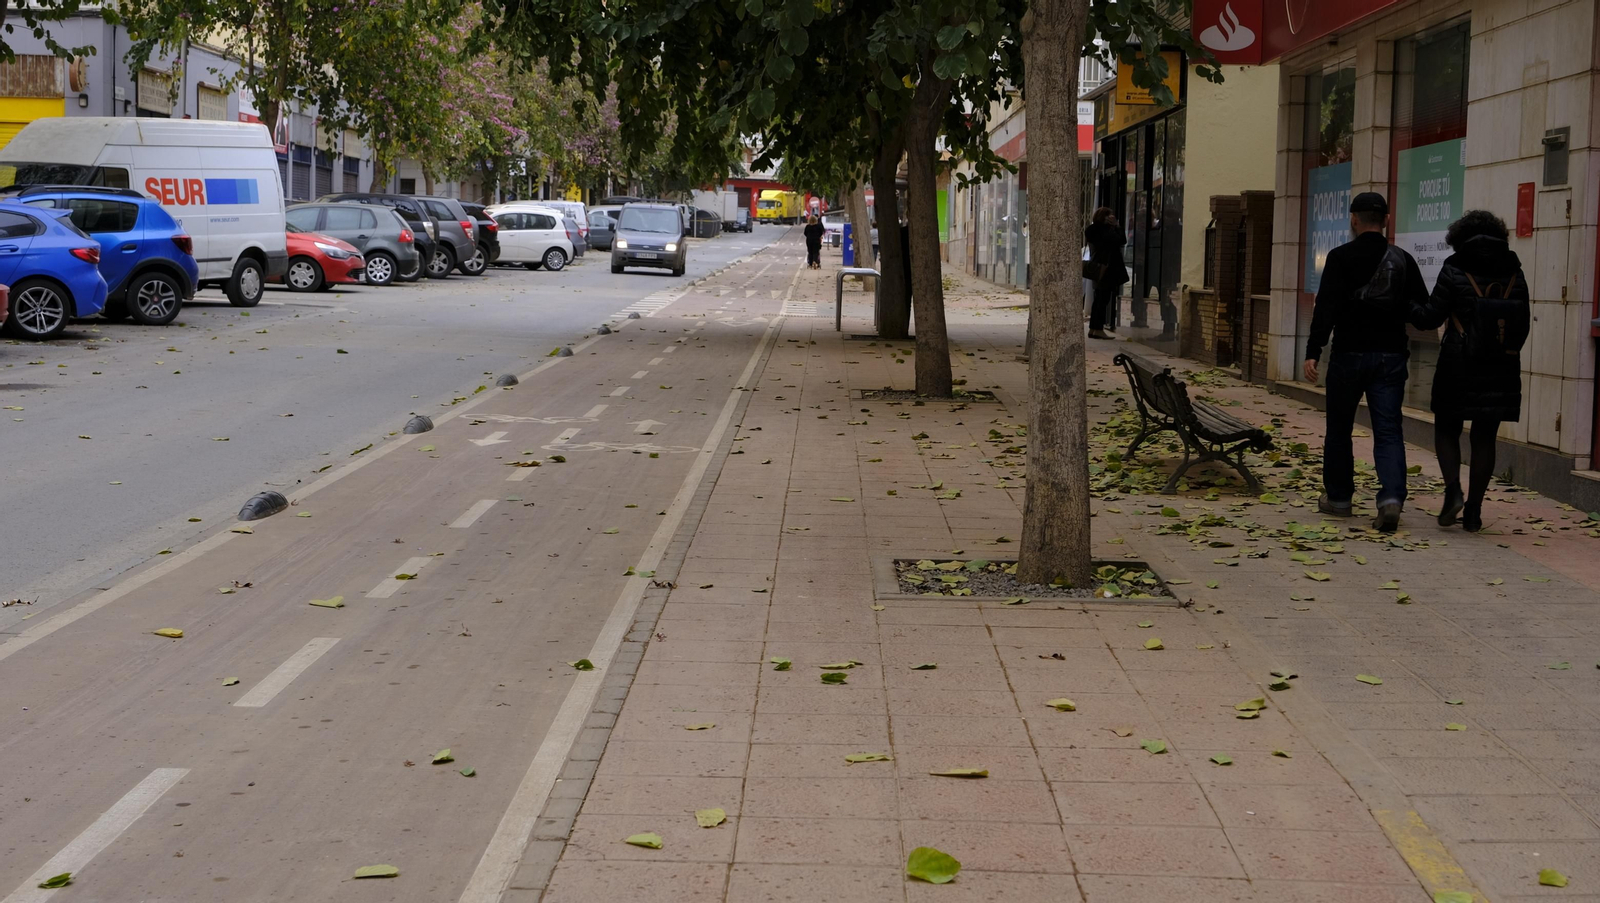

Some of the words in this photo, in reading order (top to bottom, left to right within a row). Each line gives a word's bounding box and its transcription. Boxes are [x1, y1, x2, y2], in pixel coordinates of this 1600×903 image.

[145, 177, 205, 206] SEUR
[1419, 178, 1441, 199] PORQUE
[1442, 172, 1450, 196] TÚ
[1313, 191, 1344, 223] PORQUE
[1416, 202, 1439, 223] PORQUE
[1440, 201, 1450, 220] 100
[1312, 231, 1342, 259] PORQUE
